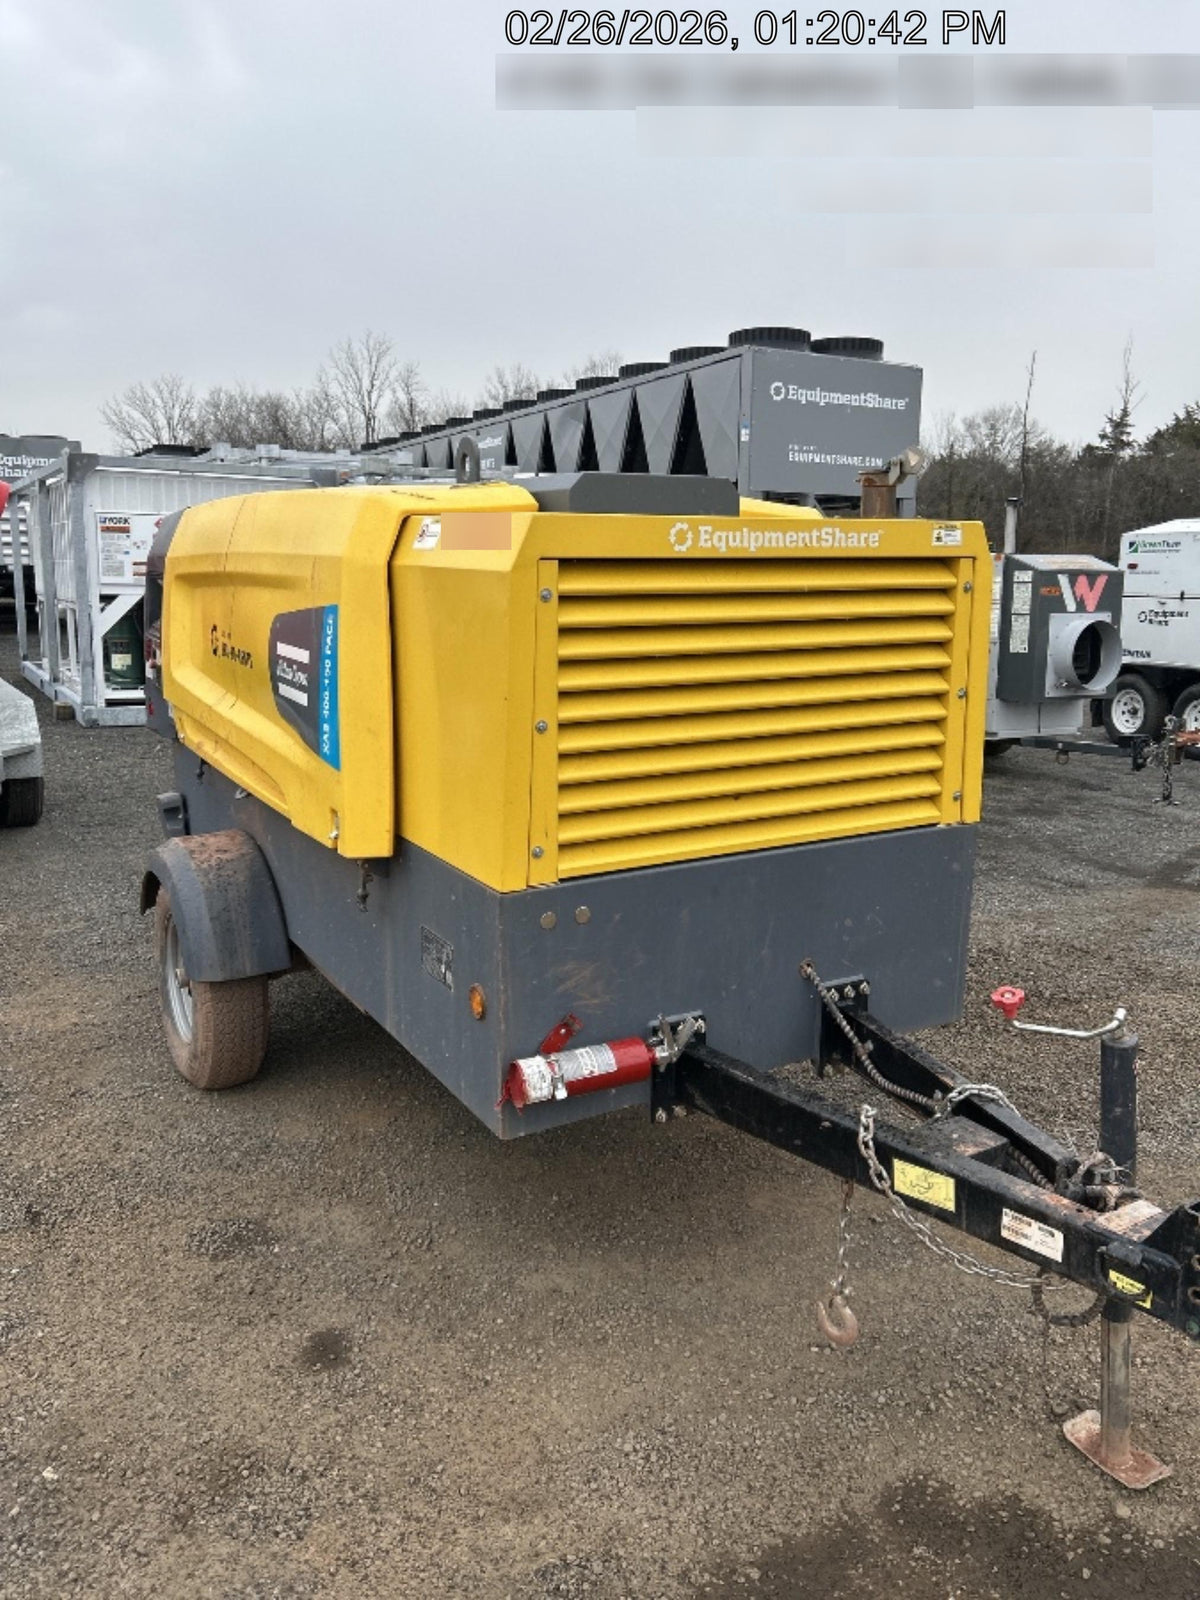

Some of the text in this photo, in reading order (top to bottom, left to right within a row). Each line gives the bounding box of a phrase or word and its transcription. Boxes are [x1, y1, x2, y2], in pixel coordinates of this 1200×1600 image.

[787, 384, 907, 409] EquipmentShare
[0, 453, 58, 468] Equipm
[0, 466, 32, 477] Shar
[698, 525, 881, 552] EquipmentShare
